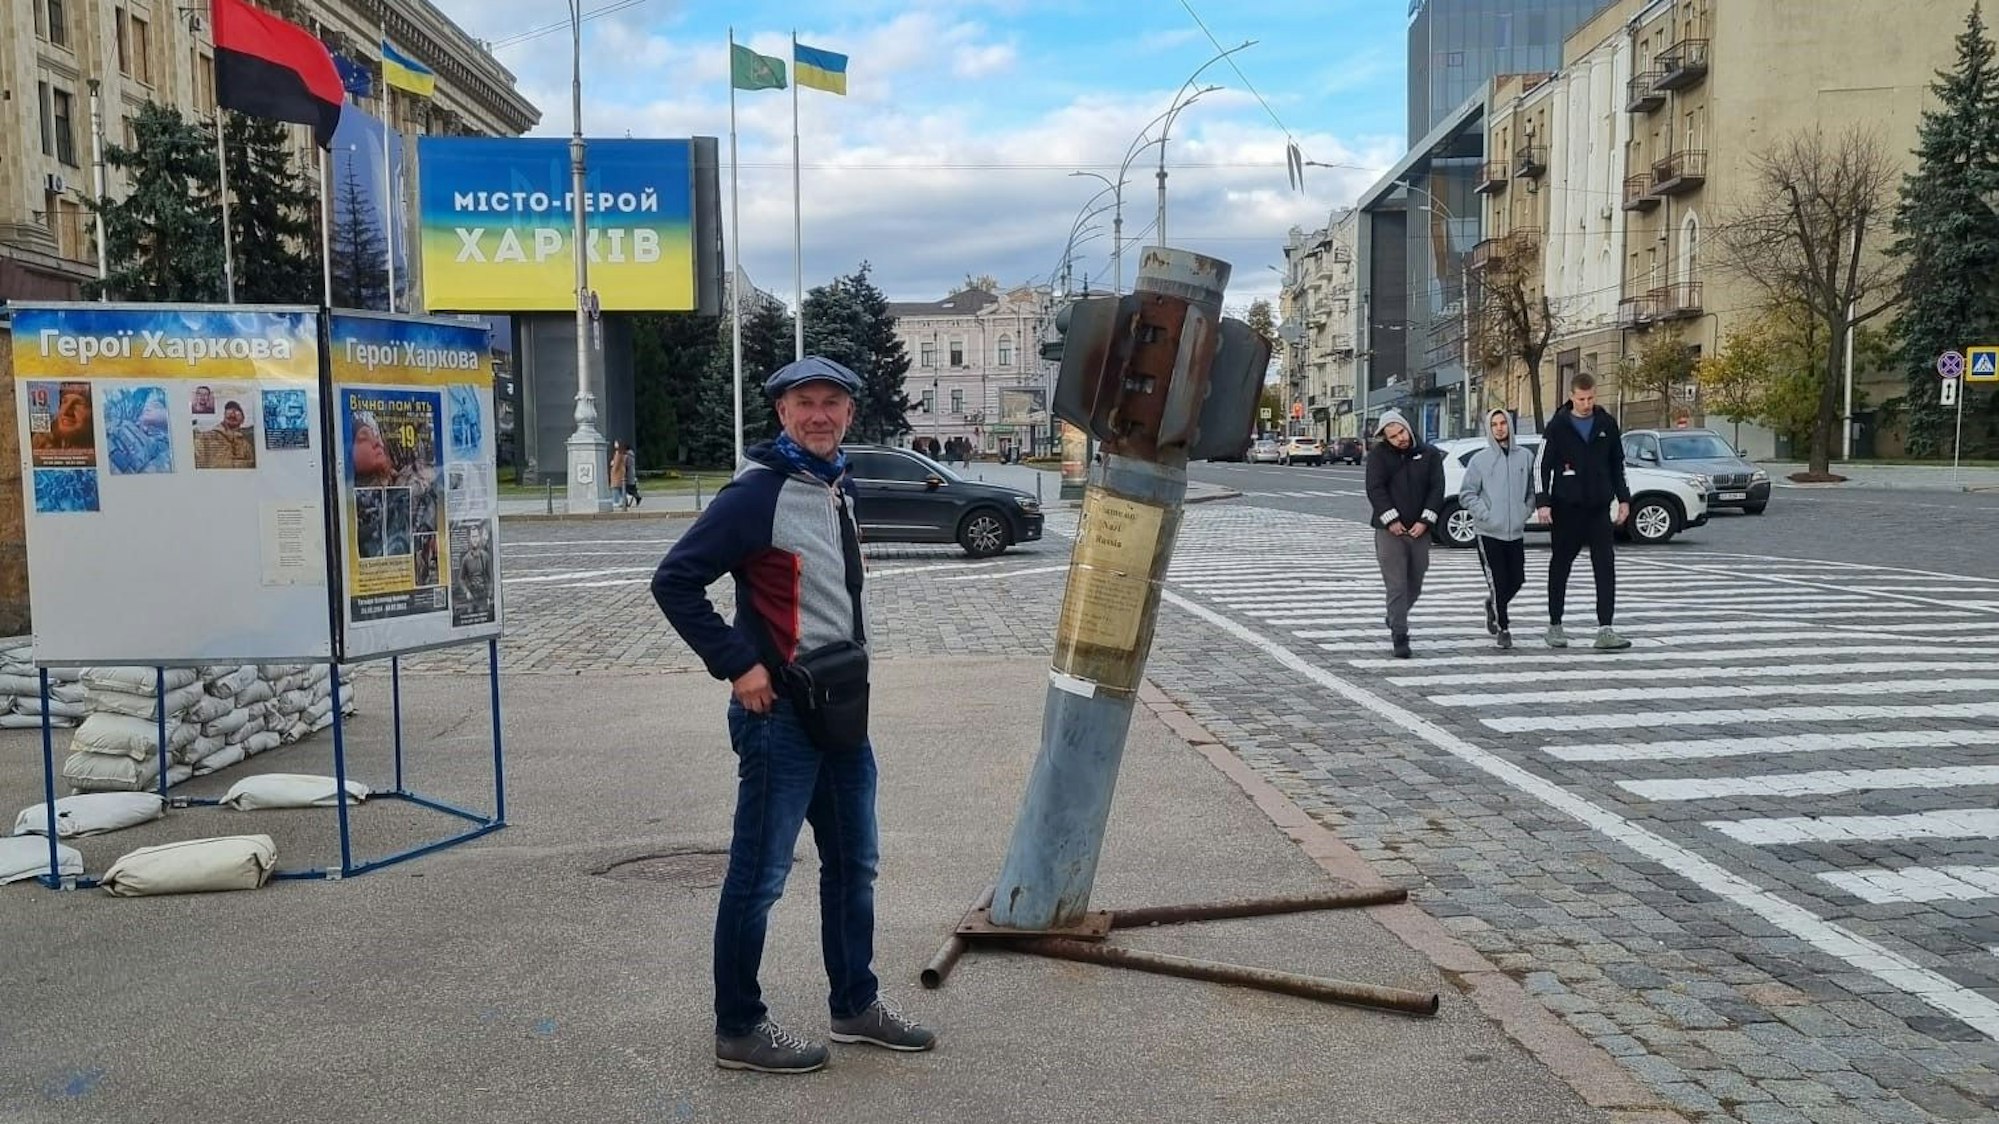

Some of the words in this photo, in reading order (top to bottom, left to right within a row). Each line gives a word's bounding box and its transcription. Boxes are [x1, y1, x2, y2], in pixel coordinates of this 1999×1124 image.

[454, 187, 658, 213] МІСТО-ГЕРОЙ
[39, 328, 133, 364] Герої
[142, 330, 291, 366] Харкова
[345, 337, 399, 370] Герої
[403, 341, 479, 374] Харкова
[31, 389, 49, 406] 19
[349, 394, 385, 411] Вічна
[399, 424, 415, 448] 19
